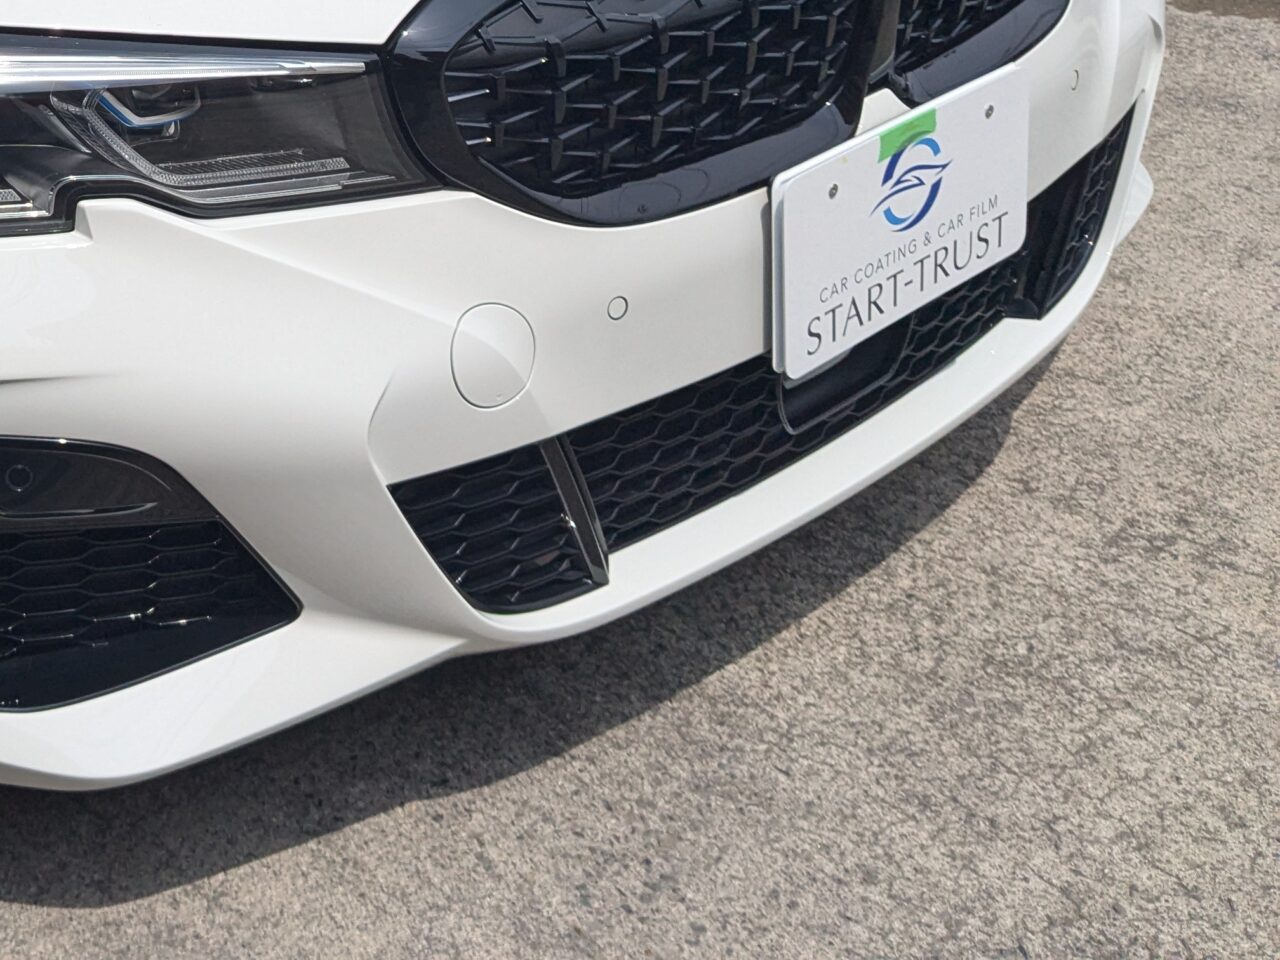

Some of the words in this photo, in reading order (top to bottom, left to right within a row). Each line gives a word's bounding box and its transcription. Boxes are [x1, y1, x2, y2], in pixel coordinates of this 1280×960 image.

[806, 211, 1009, 357] START-TRUST
[819, 276, 849, 304] CAR
[853, 238, 918, 285] COATING
[922, 231, 932, 248] &
[937, 212, 964, 239] CAR
[969, 194, 999, 222] FILM
